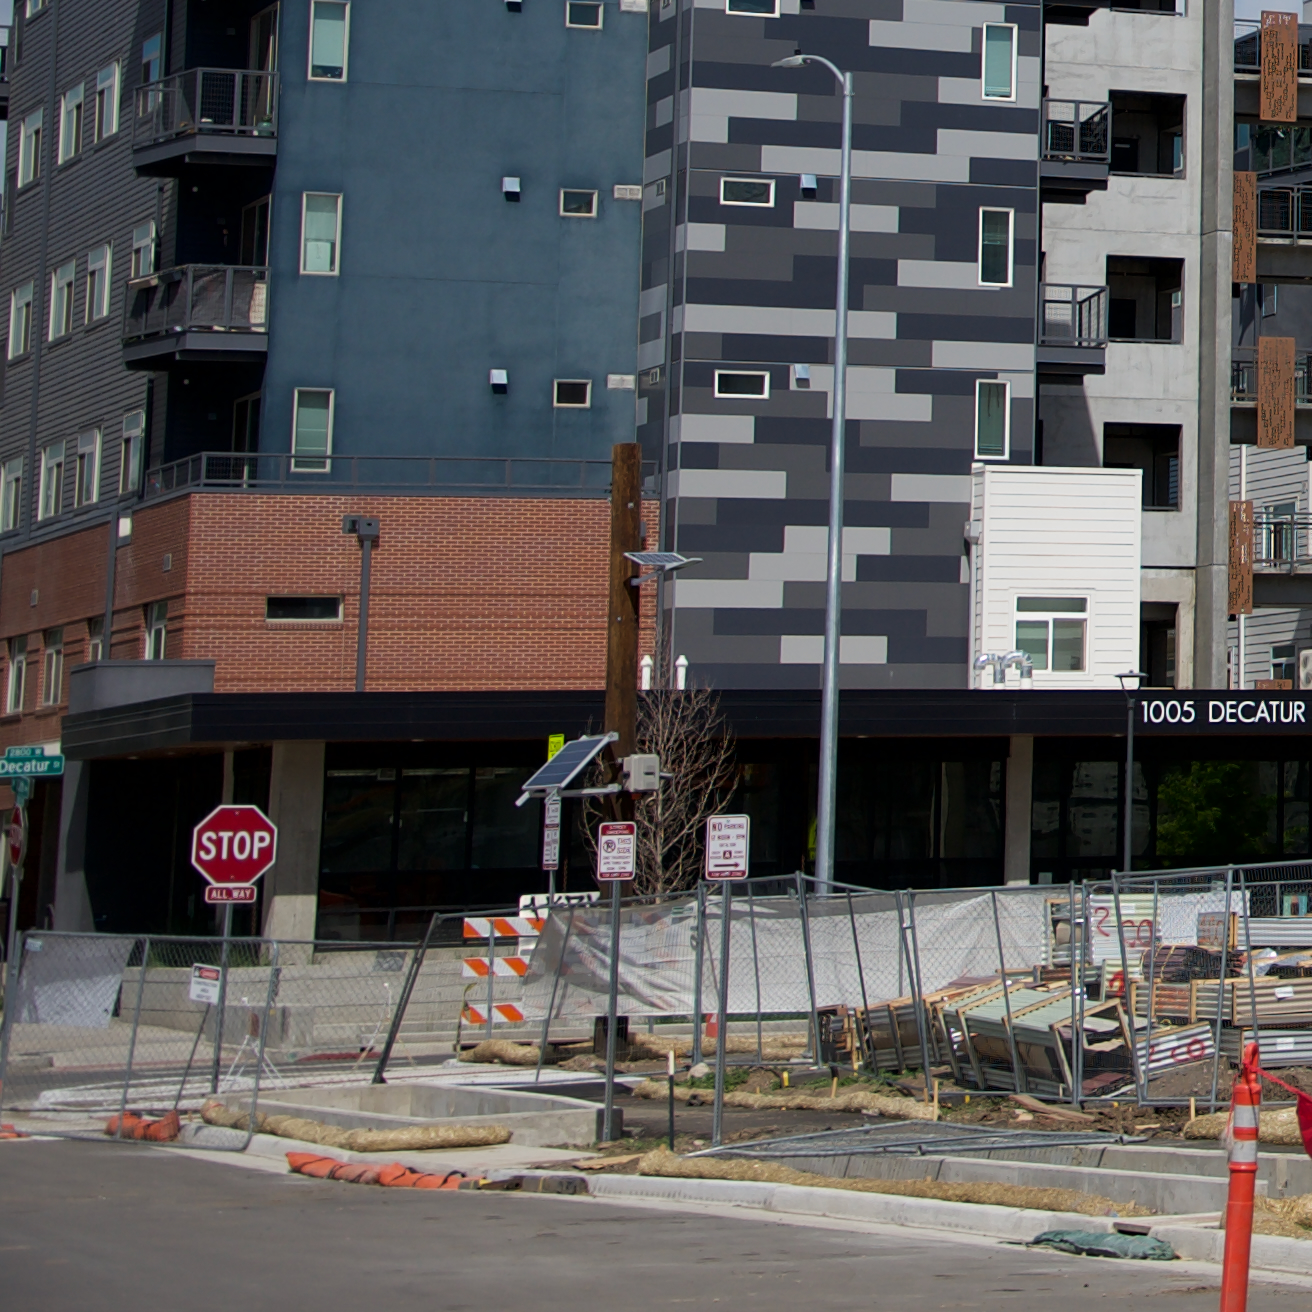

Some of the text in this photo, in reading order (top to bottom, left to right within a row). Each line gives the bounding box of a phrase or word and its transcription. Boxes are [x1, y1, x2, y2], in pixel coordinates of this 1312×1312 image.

[1141, 700, 1307, 724] 1005 DECATUR
[199, 830, 271, 861] STOP
[210, 888, 251, 900] ALL WAY
